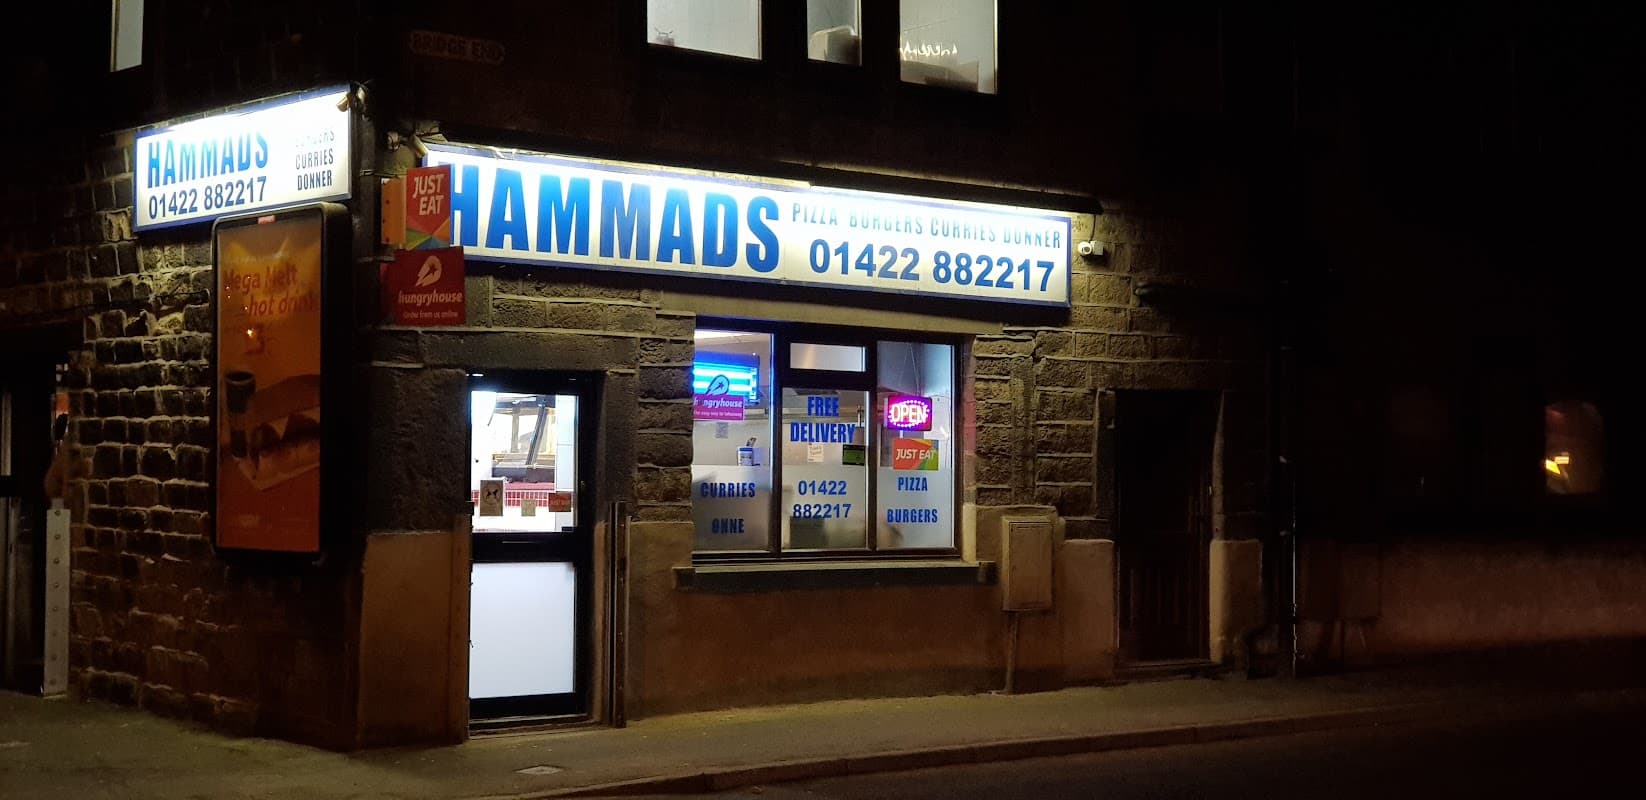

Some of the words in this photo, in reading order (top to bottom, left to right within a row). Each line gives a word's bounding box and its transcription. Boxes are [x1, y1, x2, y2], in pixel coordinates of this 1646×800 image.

[413, 33, 467, 55] BRIDGE
[471, 41, 502, 60] END
[147, 129, 268, 188] HAMMADS
[296, 148, 333, 170] CURRIES
[297, 169, 332, 191] DONNER
[413, 174, 444, 197] JUST
[149, 188, 198, 219] 01422
[204, 175, 267, 210] 882217
[419, 195, 444, 216] EAT
[438, 161, 779, 273] HAMMADS
[791, 203, 838, 227] PIZZA
[849, 209, 923, 236] BURGERS
[930, 216, 995, 242] CURRIES
[1003, 225, 1062, 249] DONNER
[809, 239, 920, 281] 01422
[933, 251, 1055, 292] 882217
[248, 294, 275, 317] hot
[398, 290, 463, 307] hungryhouse
[694, 397, 742, 408] hngryhouse
[807, 396, 840, 417] FREE
[892, 403, 928, 424] OPEN
[790, 422, 856, 443] DELIVERY
[896, 448, 919, 460] JUST
[919, 449, 937, 460] EAT
[700, 482, 756, 498] CURRIES
[798, 480, 847, 496] 01422
[897, 476, 928, 492] PIZZA
[793, 503, 851, 519] 882217
[886, 508, 938, 523] BURGERS
